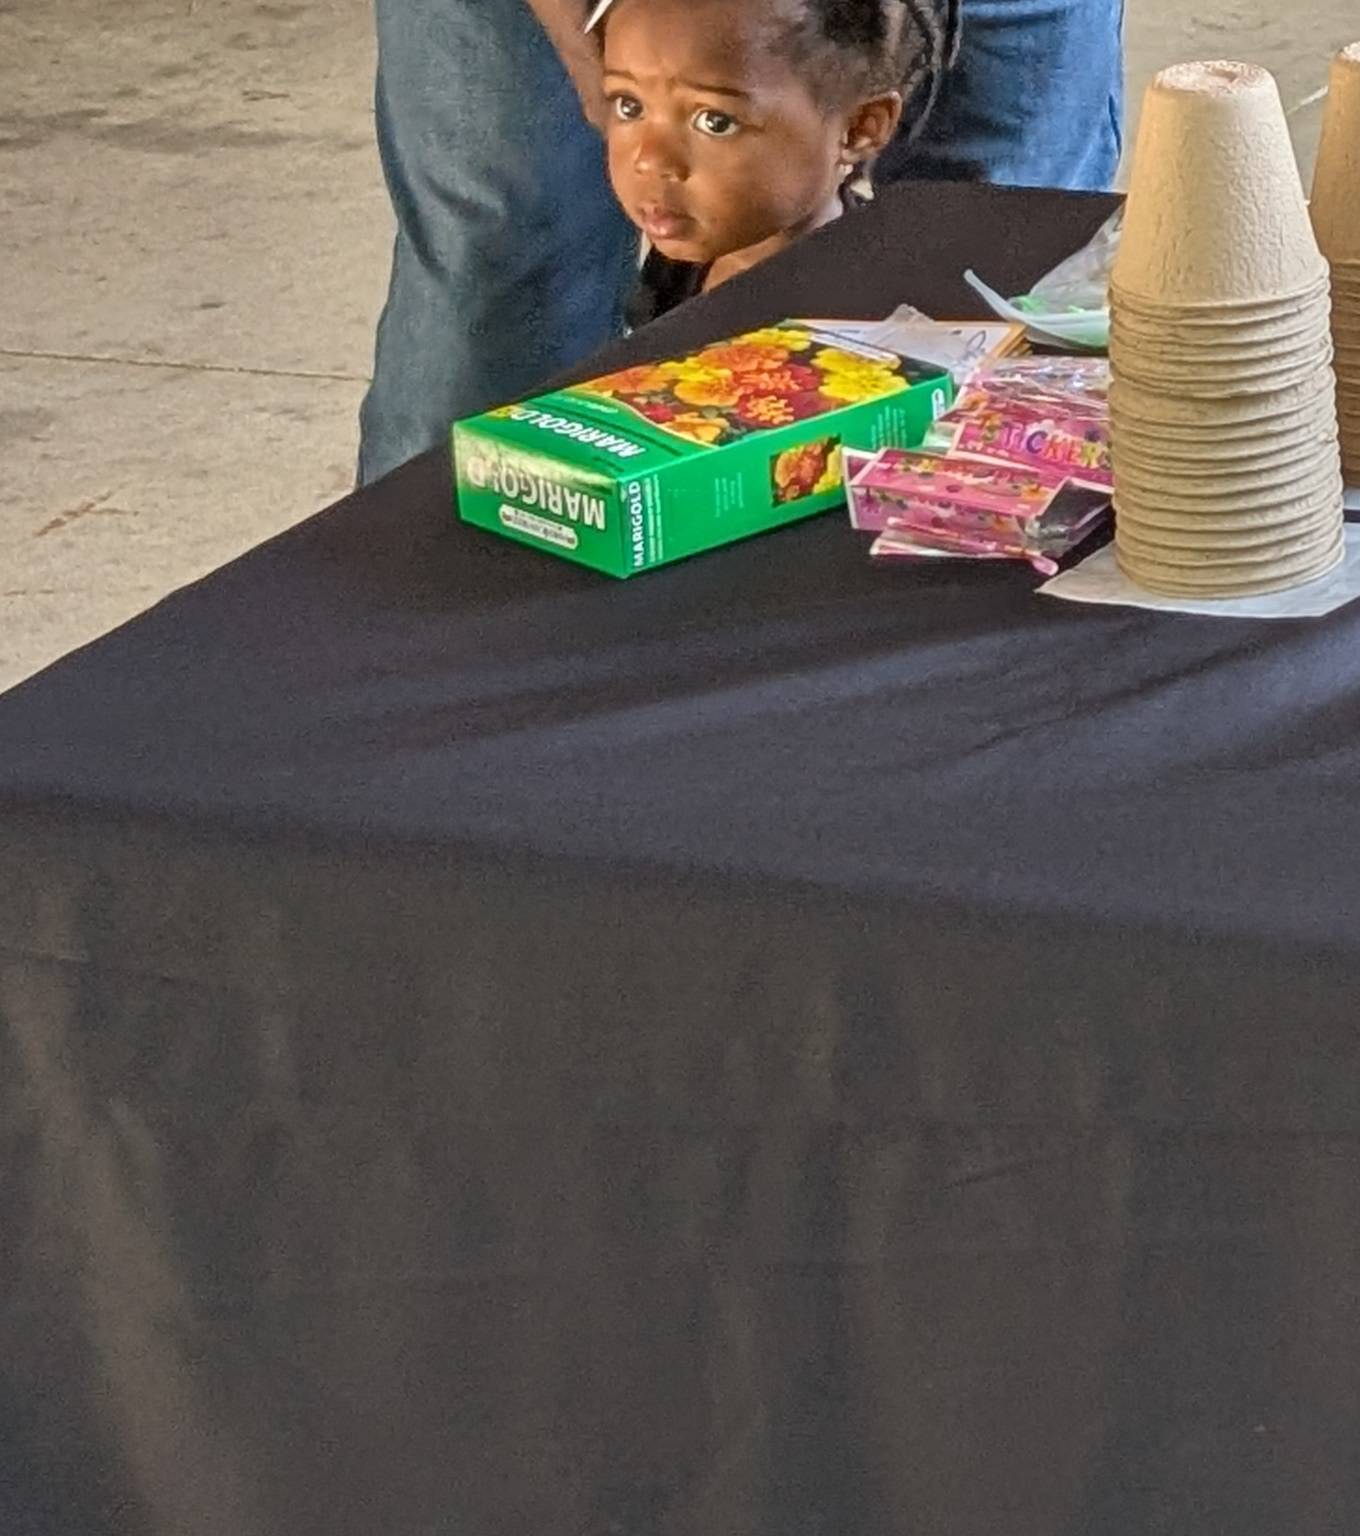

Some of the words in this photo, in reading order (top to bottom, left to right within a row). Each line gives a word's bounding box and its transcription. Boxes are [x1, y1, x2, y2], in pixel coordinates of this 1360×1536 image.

[509, 409, 646, 458] MARIGOLD
[465, 455, 606, 530] MARIGOLD
[628, 480, 645, 568] MARIGOLD
